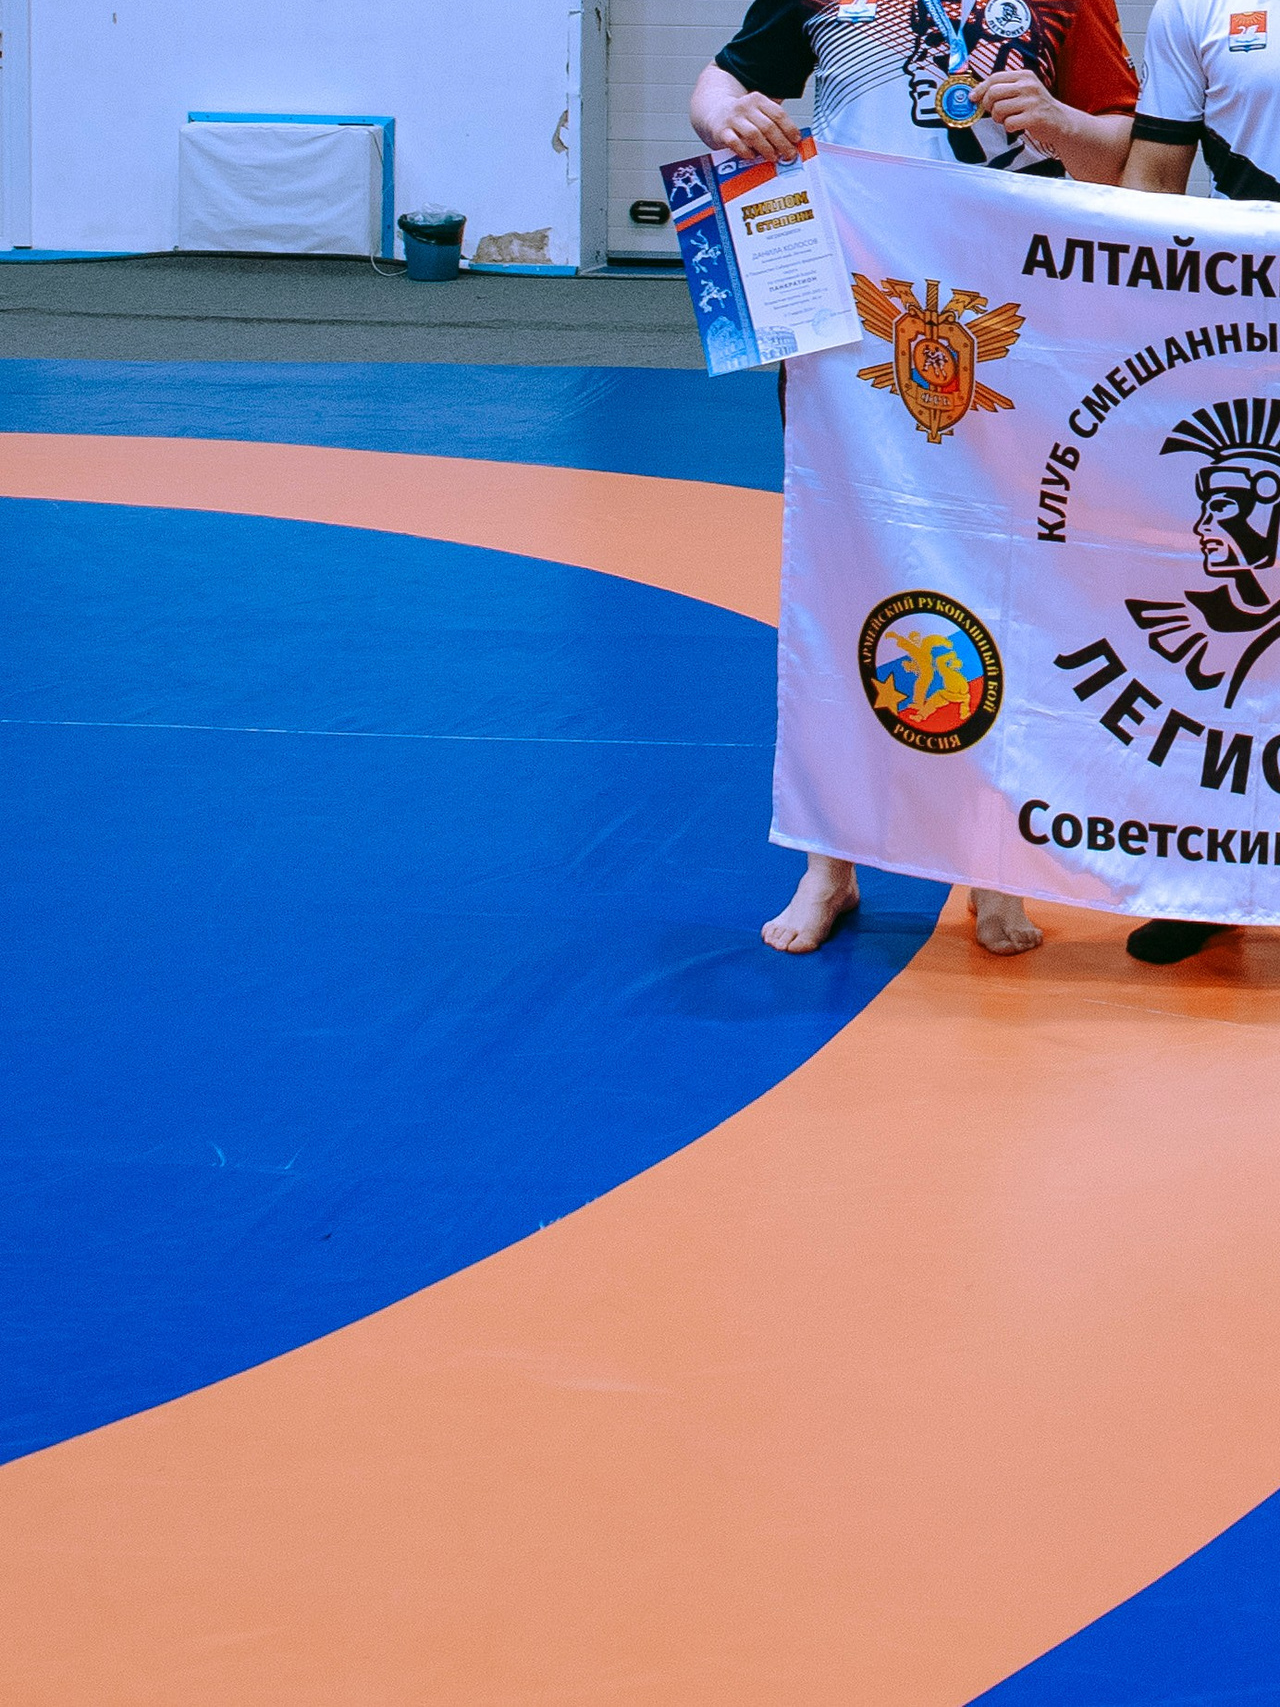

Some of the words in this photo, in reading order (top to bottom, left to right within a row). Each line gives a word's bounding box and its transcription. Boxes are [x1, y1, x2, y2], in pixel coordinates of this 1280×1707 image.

[741, 190, 809, 221] ДИПЛОМ
[1037, 442, 1080, 543] КЛУБ
[863, 596, 914, 664] АРМЕЙСКИЙ
[918, 597, 999, 677] РУКОПАШНЫЙ
[983, 680, 999, 713] БОЙ
[894, 723, 961, 749] РОССИЯ
